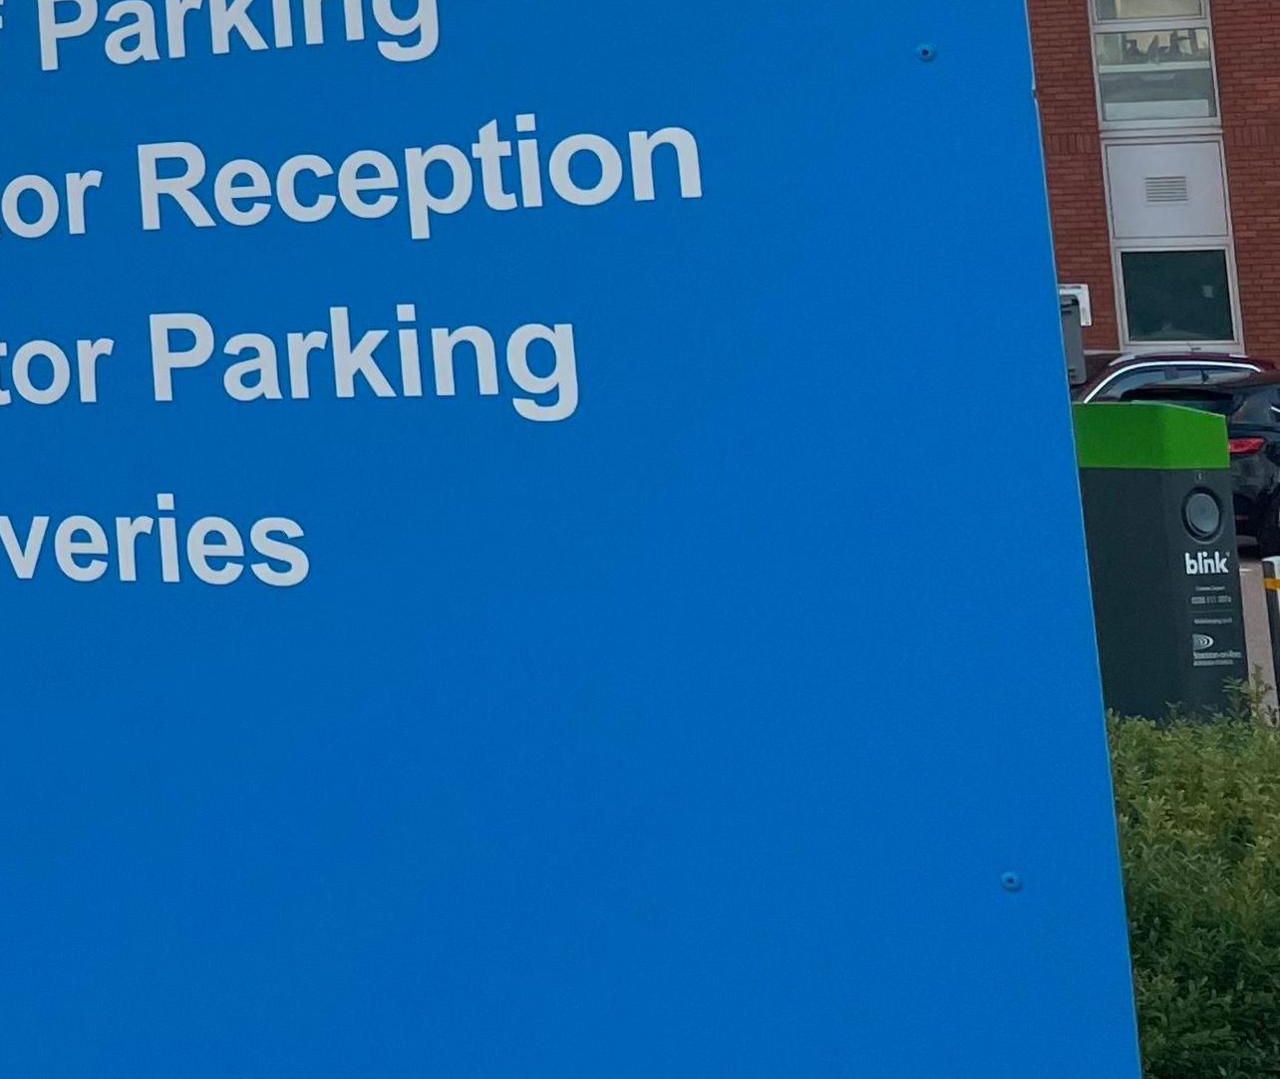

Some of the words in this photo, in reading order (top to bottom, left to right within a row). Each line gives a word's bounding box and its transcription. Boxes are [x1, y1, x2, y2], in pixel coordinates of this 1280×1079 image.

[137, 113, 703, 240] Reception
[149, 304, 579, 422] Parking
[1184, 551, 1229, 575] blink
